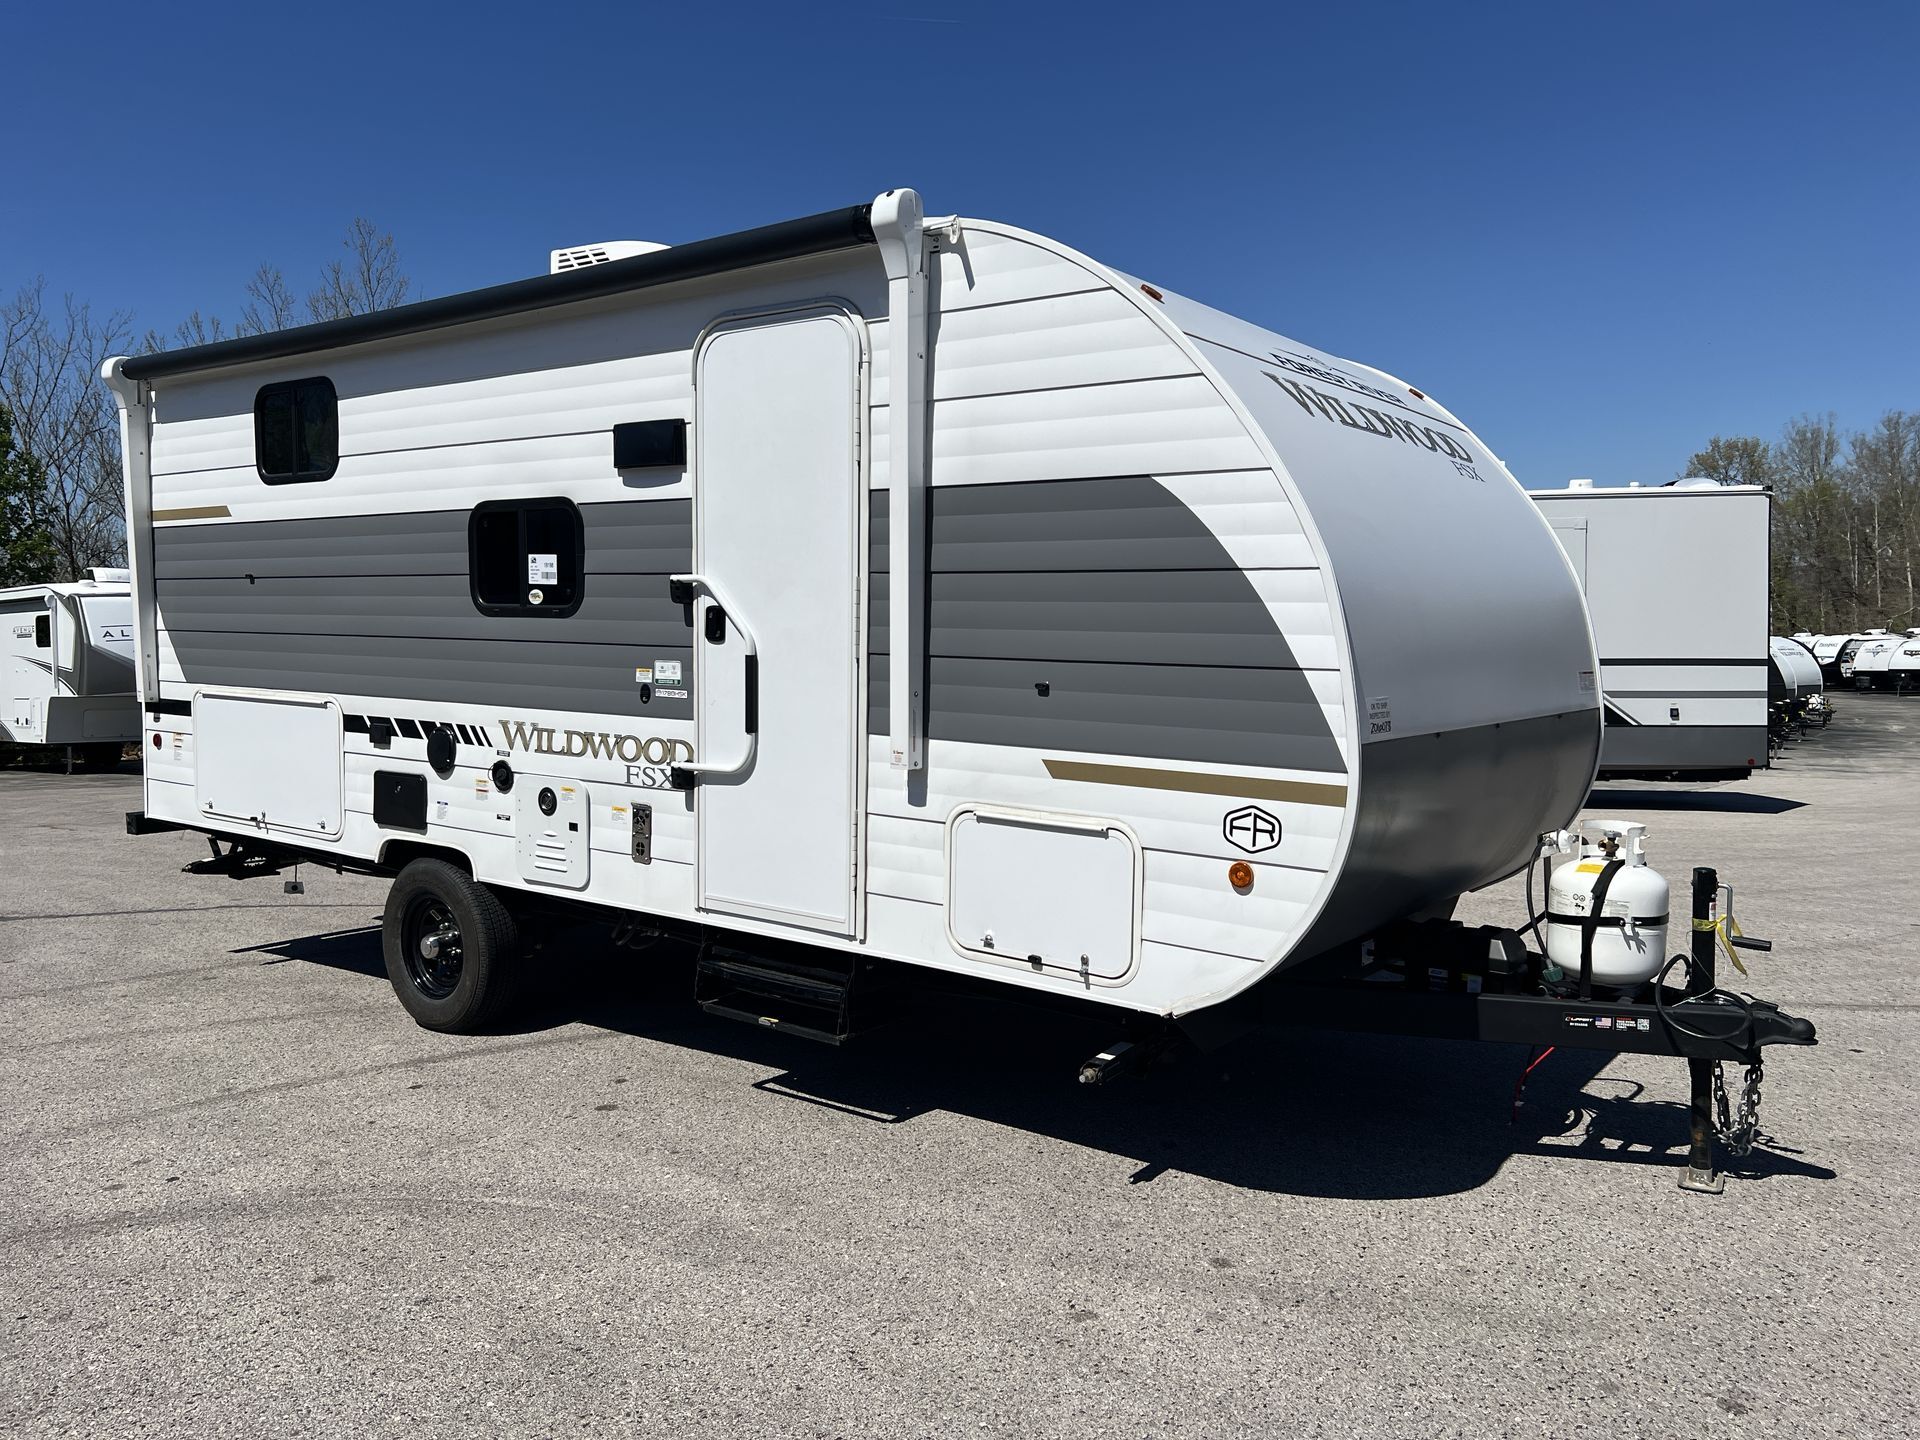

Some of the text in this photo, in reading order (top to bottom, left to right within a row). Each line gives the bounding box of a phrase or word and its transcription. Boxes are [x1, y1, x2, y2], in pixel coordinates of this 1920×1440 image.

[1268, 352, 1408, 407] FOREST RIVER
[1261, 370, 1474, 464] WILDWOOD
[1450, 460, 1486, 482] FSX
[499, 719, 695, 767] WILDWOOD
[624, 764, 673, 789] FSX
